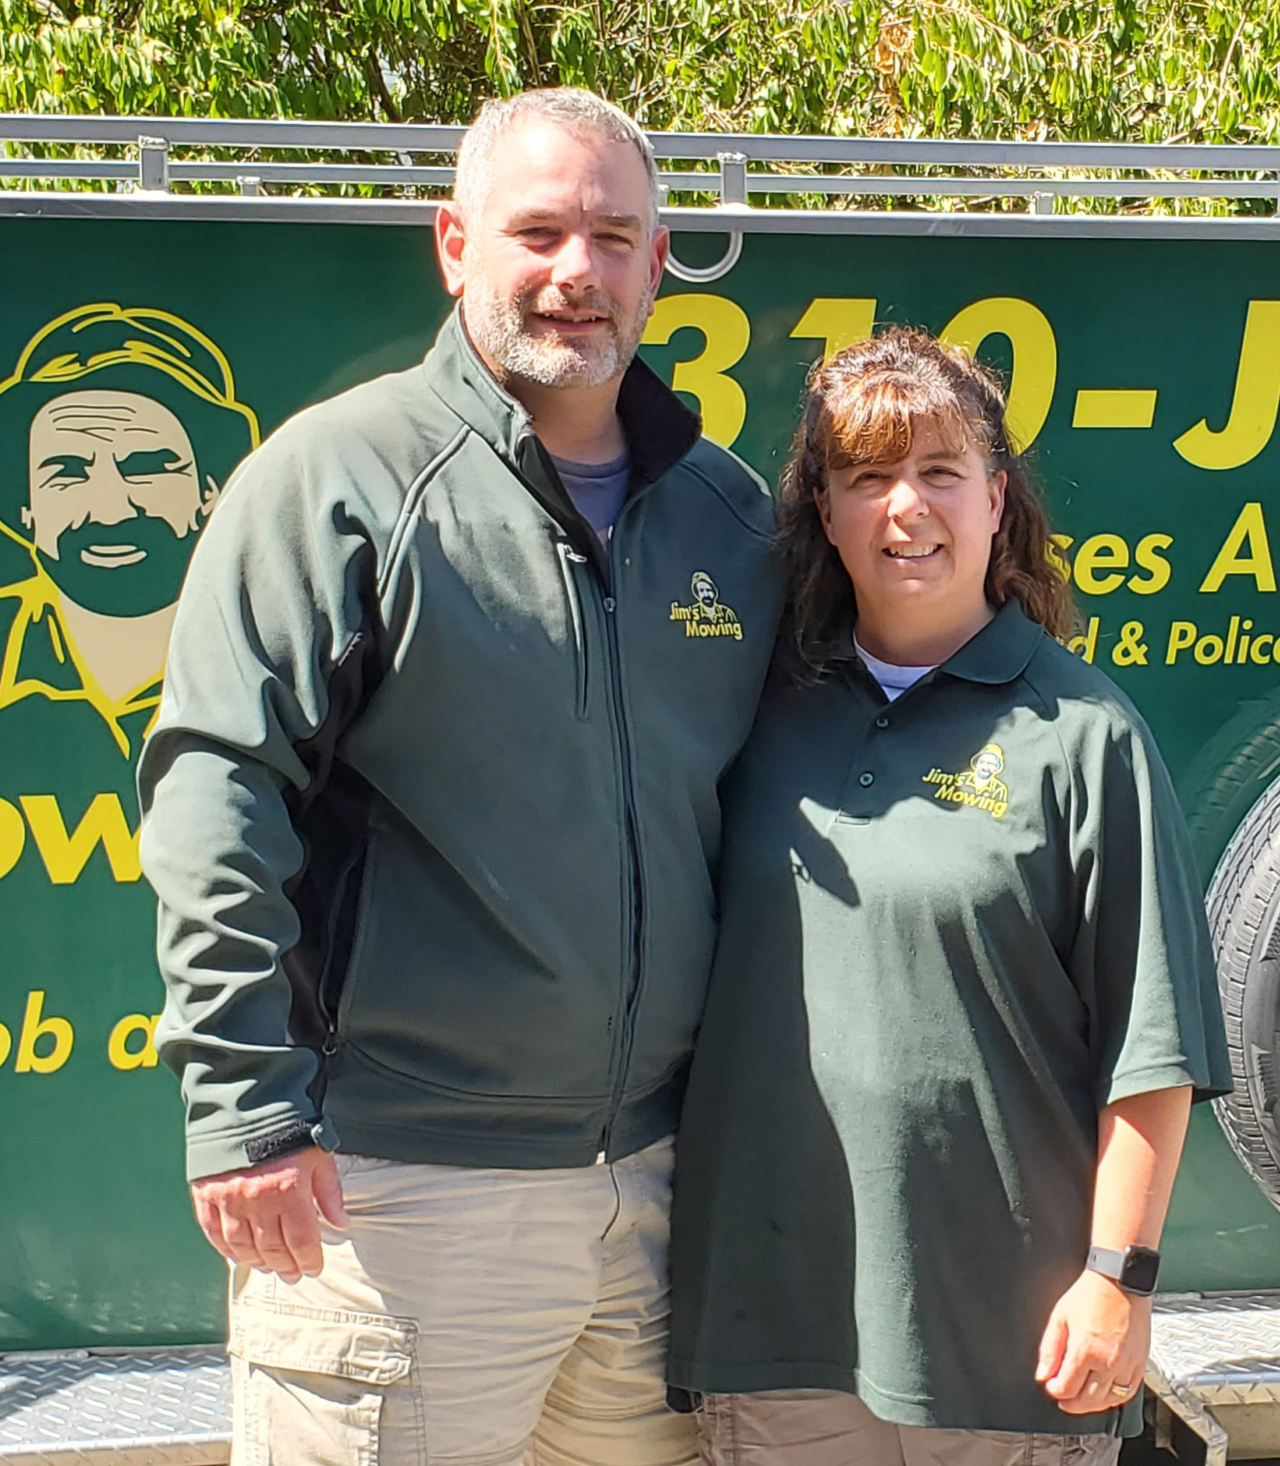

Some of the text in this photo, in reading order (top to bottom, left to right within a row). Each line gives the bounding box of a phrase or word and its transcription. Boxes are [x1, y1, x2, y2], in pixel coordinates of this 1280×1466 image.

[671, 602, 700, 620] Jim's
[686, 618, 743, 641] Mowing
[1113, 622, 1147, 666] &
[922, 768, 965, 786] Jim's
[934, 783, 1008, 818] Mowing
